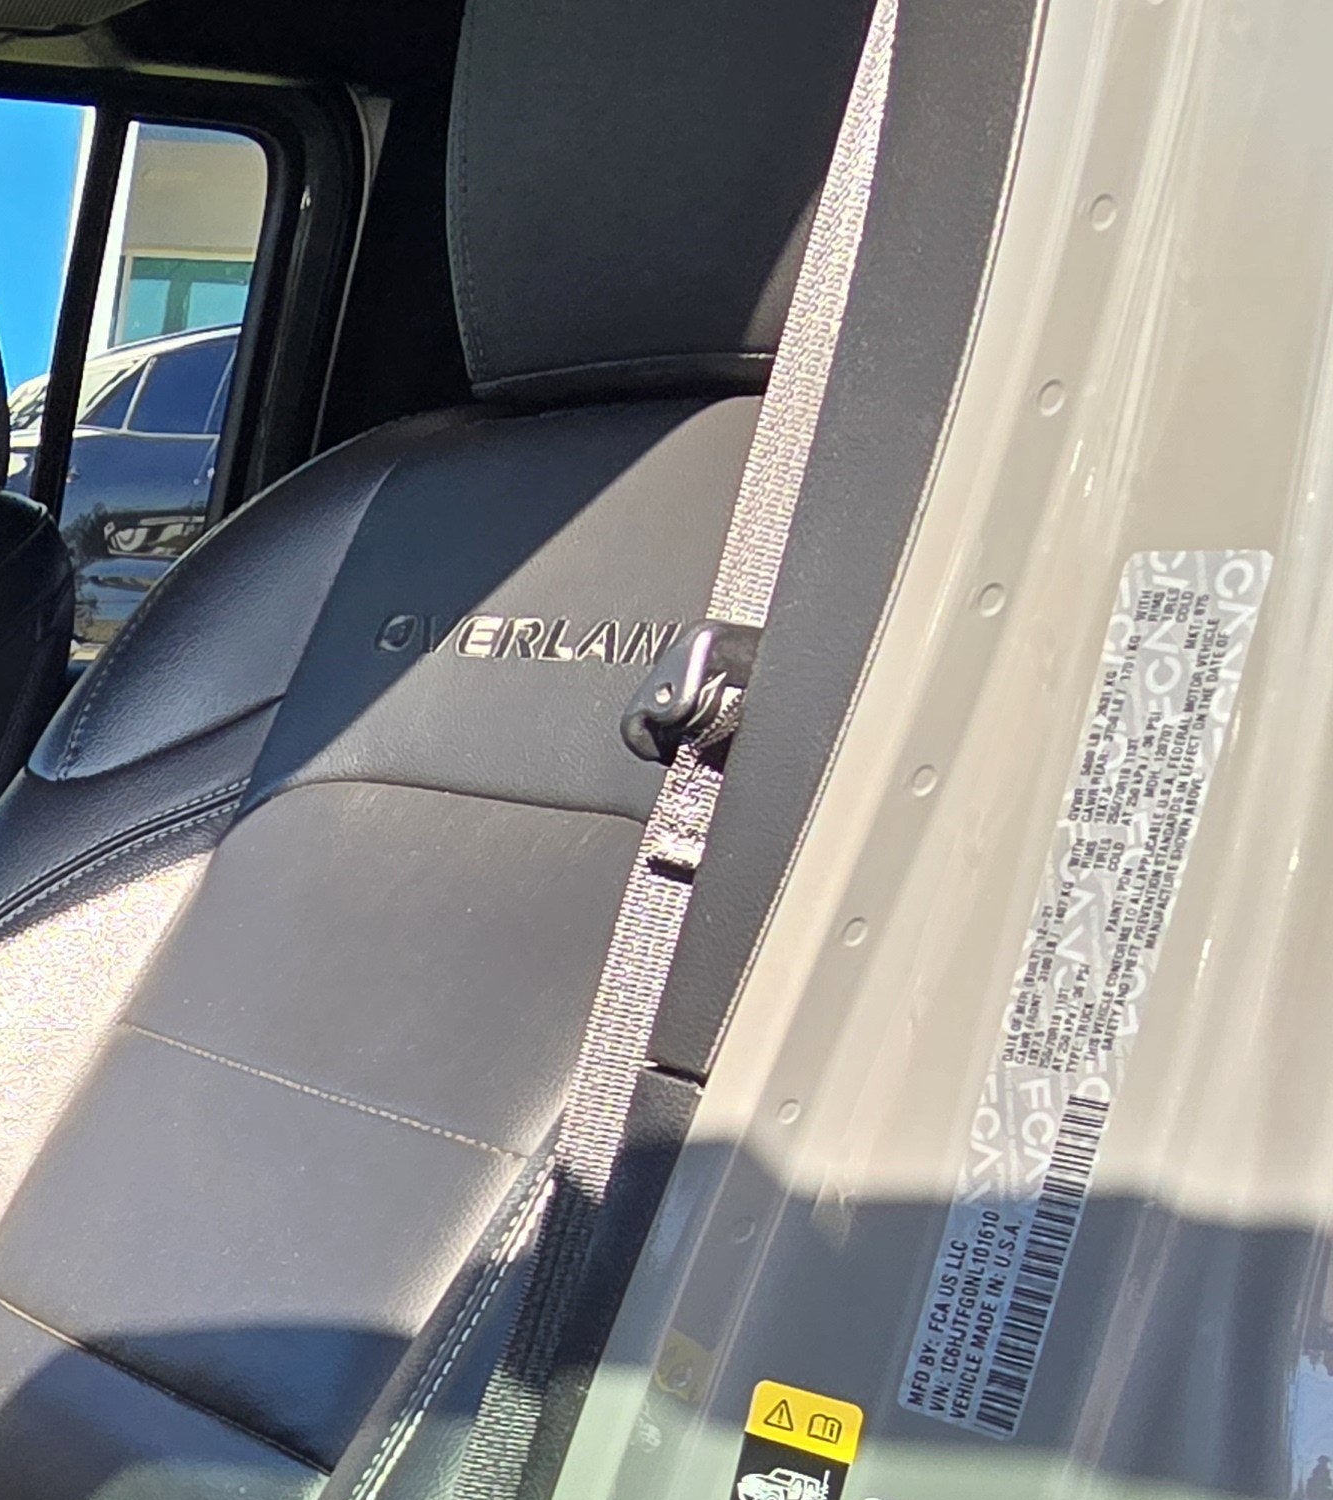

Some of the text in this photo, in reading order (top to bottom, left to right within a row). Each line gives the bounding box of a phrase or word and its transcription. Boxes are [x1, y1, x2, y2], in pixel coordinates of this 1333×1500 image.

[1127, 635, 1141, 651] KG
[1134, 589, 1152, 621] WITH
[1147, 591, 1165, 622] RIMS
[374, 613, 682, 666] OVERLAN
[1195, 618, 1219, 667] VEHICLE
[1104, 670, 1117, 686] KG
[1182, 671, 1204, 712] MOTOR
[1120, 810, 1133, 826] AT
[1175, 590, 1194, 623] COLD
[1167, 716, 1193, 769] FEDERAL
[1080, 840, 1097, 868] RIMS
[1093, 837, 1112, 869] TIRES
[1100, 631, 1229, 1050] SAFETY AND THEFT PREVENTION STANDARDS IN EFFECT ON THE DATE OF
[1136, 812, 1165, 880] APPLICABLE
[1169, 817, 1192, 860] SHOWN
[1060, 881, 1074, 896] KG
[1068, 836, 1085, 866] WITH
[1123, 907, 1138, 922] TO
[1129, 884, 1145, 904] ALL
[1050, 1056, 1064, 1072] AT
[1107, 841, 1125, 872] COLD
[1105, 926, 1132, 987] CONFORMS
[1074, 1002, 1095, 1037] TRUCK
[1091, 990, 1114, 1034] VEHICLE
[907, 1239, 967, 1405] MFD BY: FCA US LLC
[949, 1220, 1022, 1418] VEHICLE MADE IN: U.S.A.
[929, 1380, 951, 1411] VIN:
